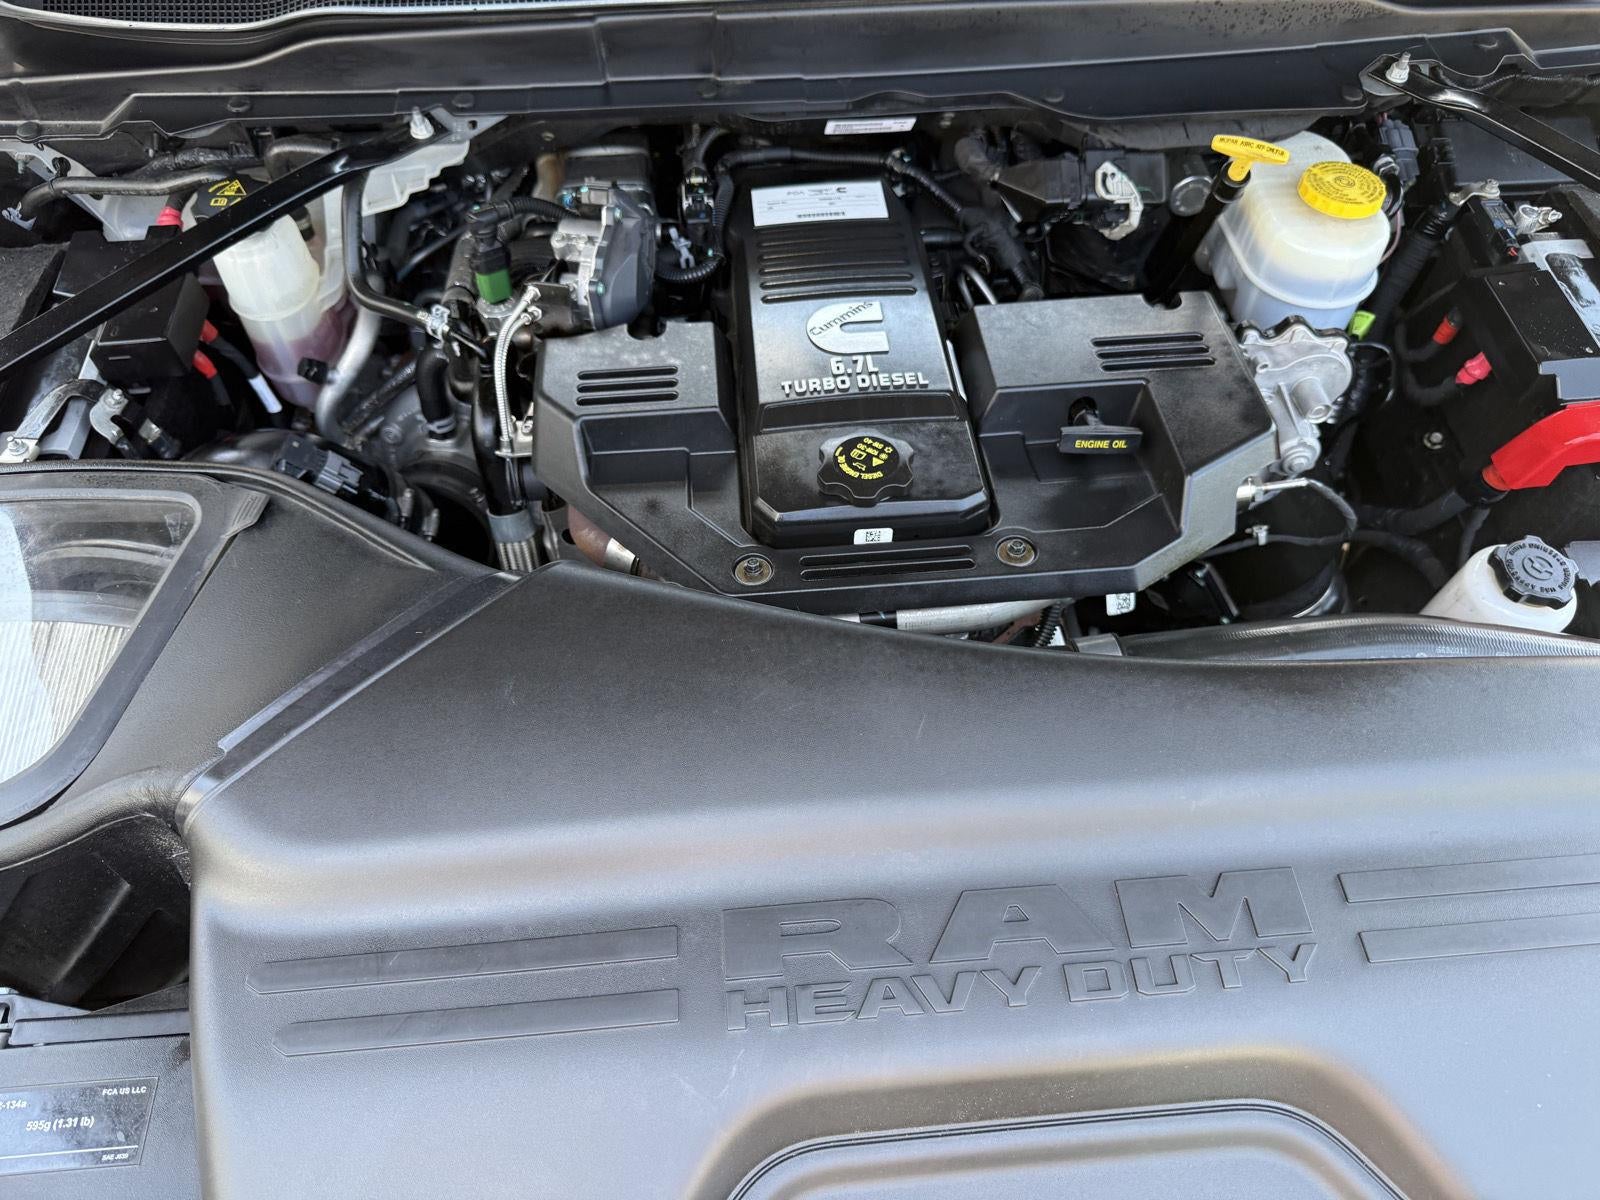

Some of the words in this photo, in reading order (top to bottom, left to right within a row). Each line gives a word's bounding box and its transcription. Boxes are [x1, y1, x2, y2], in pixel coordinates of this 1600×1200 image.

[809, 301, 873, 336] Cummins
[830, 354, 879, 375] 6.7L
[781, 375, 851, 396] TURBO
[856, 372, 929, 391] DIESEL
[1074, 439, 1109, 449] ENGINE
[1112, 439, 1128, 449] OIL
[721, 866, 1314, 982] RAM
[726, 965, 1042, 1031] HEAVY
[1063, 942, 1318, 1004] DUTY
[102, 1088, 118, 1096] FCA
[119, 1087, 130, 1095] US
[131, 1086, 147, 1094] LLC
[25, 1121, 51, 1133] 595g
[52, 1116, 78, 1132] (1.31
[80, 1115, 95, 1129] lb)
[101, 1153, 115, 1161] SAE
